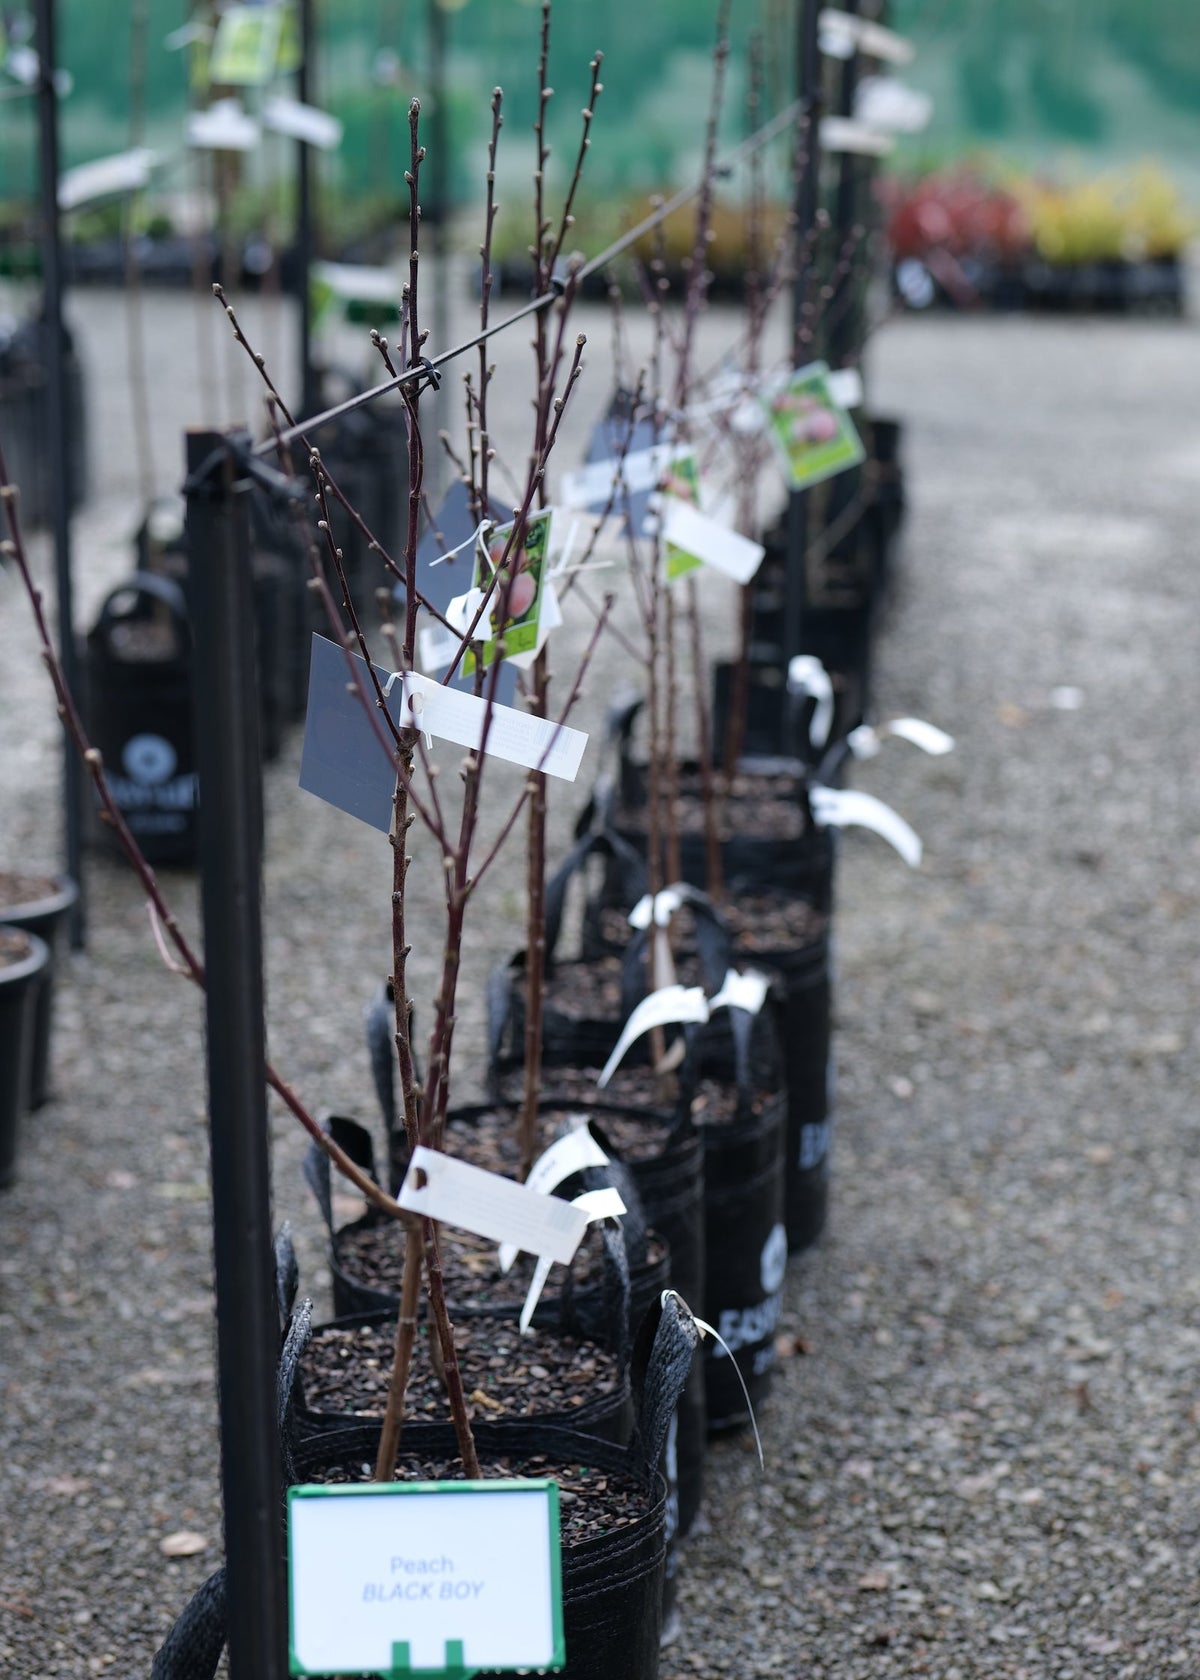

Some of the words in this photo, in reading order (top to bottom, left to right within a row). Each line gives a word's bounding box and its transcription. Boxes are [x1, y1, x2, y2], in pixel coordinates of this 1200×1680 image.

[390, 1555, 454, 1574] Peach
[362, 1582, 434, 1602] BLACK
[439, 1580, 485, 1600] BOY
